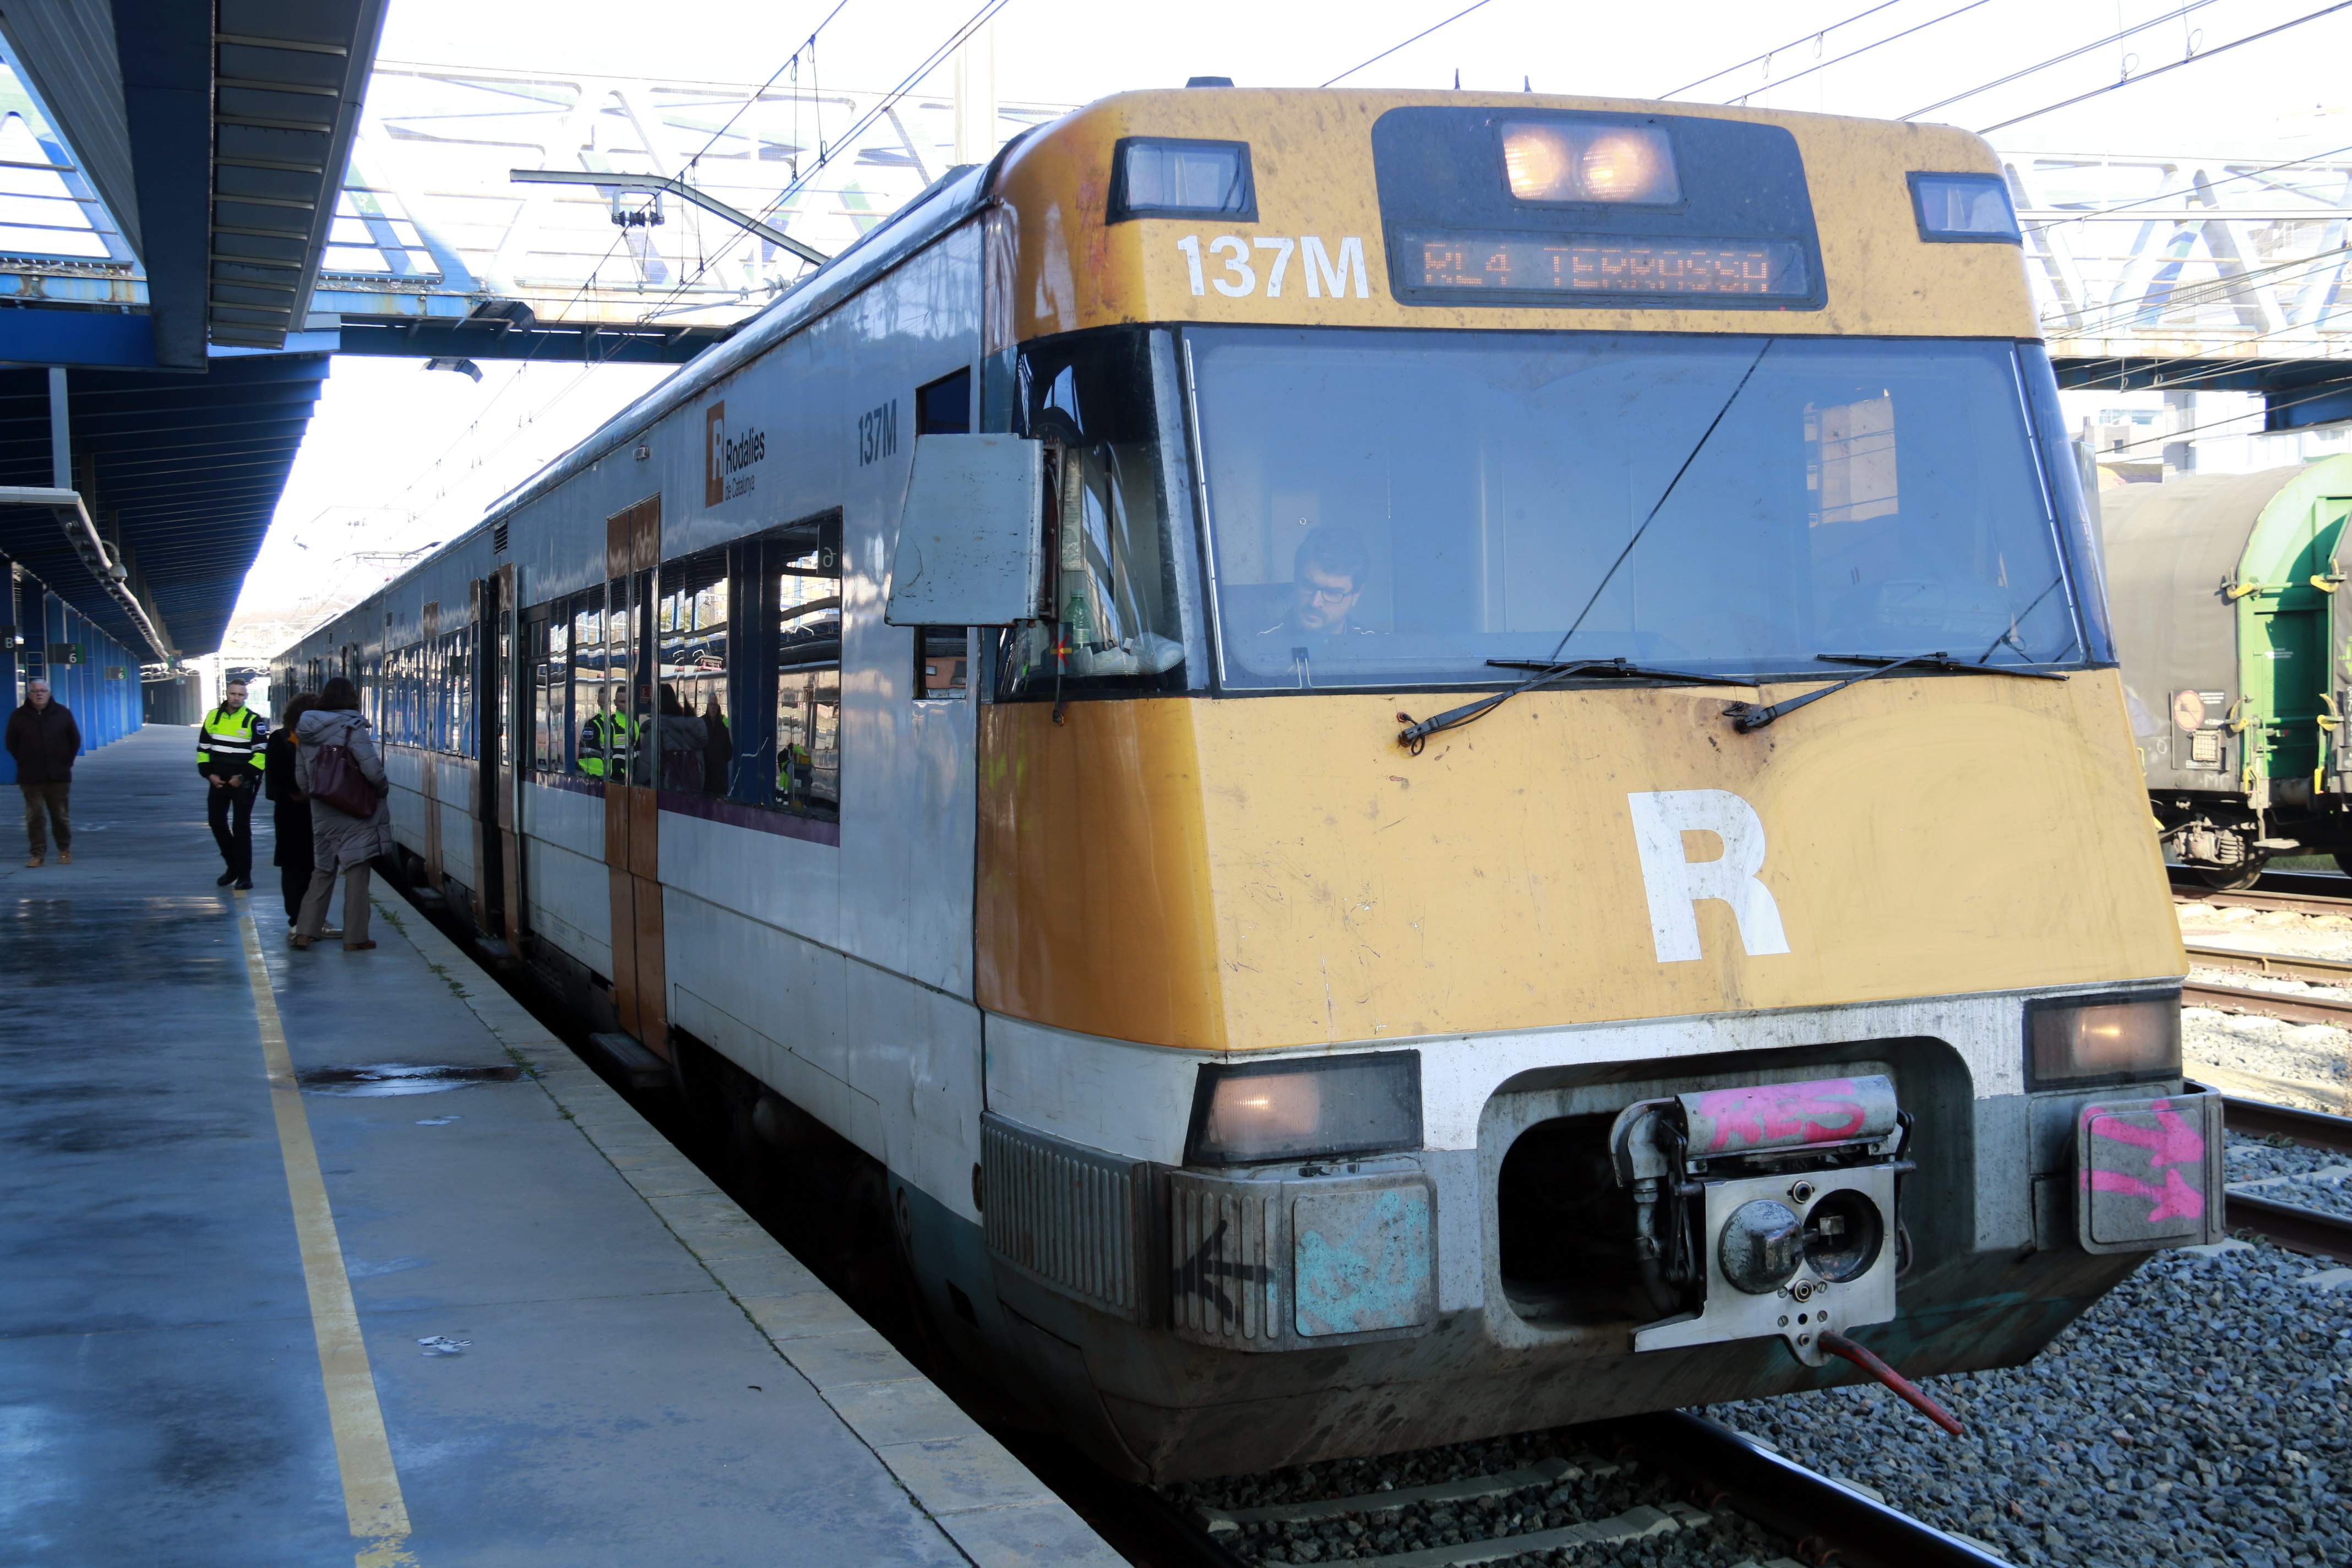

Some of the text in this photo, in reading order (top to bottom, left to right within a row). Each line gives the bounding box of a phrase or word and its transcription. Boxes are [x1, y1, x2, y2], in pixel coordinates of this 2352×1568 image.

[1177, 235, 1370, 299] 137M
[726, 427, 765, 476] Rodalies
[858, 398, 897, 467] 137M
[725, 475, 755, 502] de Catalunya
[5, 637, 14, 649] B
[69, 653, 77, 663] 6
[1627, 789, 1791, 963] R
